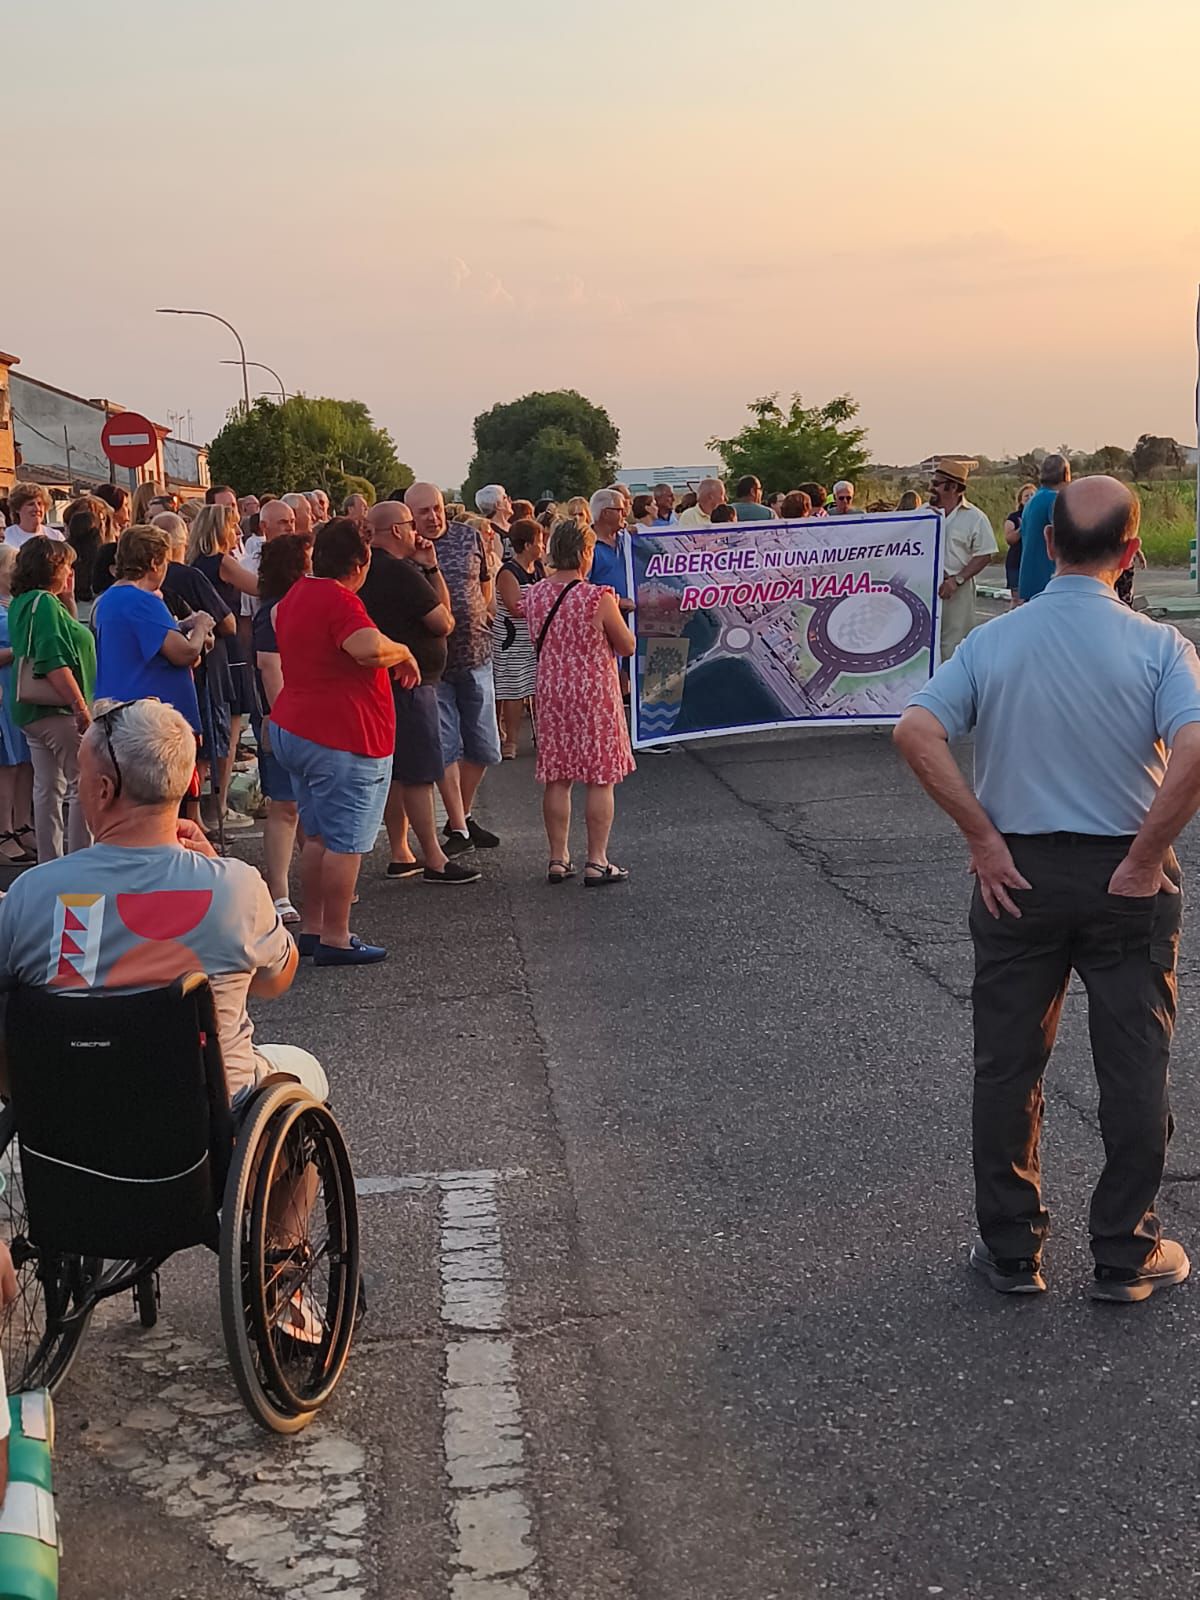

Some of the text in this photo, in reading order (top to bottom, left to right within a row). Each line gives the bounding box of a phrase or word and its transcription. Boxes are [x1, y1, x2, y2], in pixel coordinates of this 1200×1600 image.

[647, 539, 925, 576] ALBERCHE. NI UNA MUERTE MÁS.
[681, 572, 891, 609] ROTONDA YAAA...
